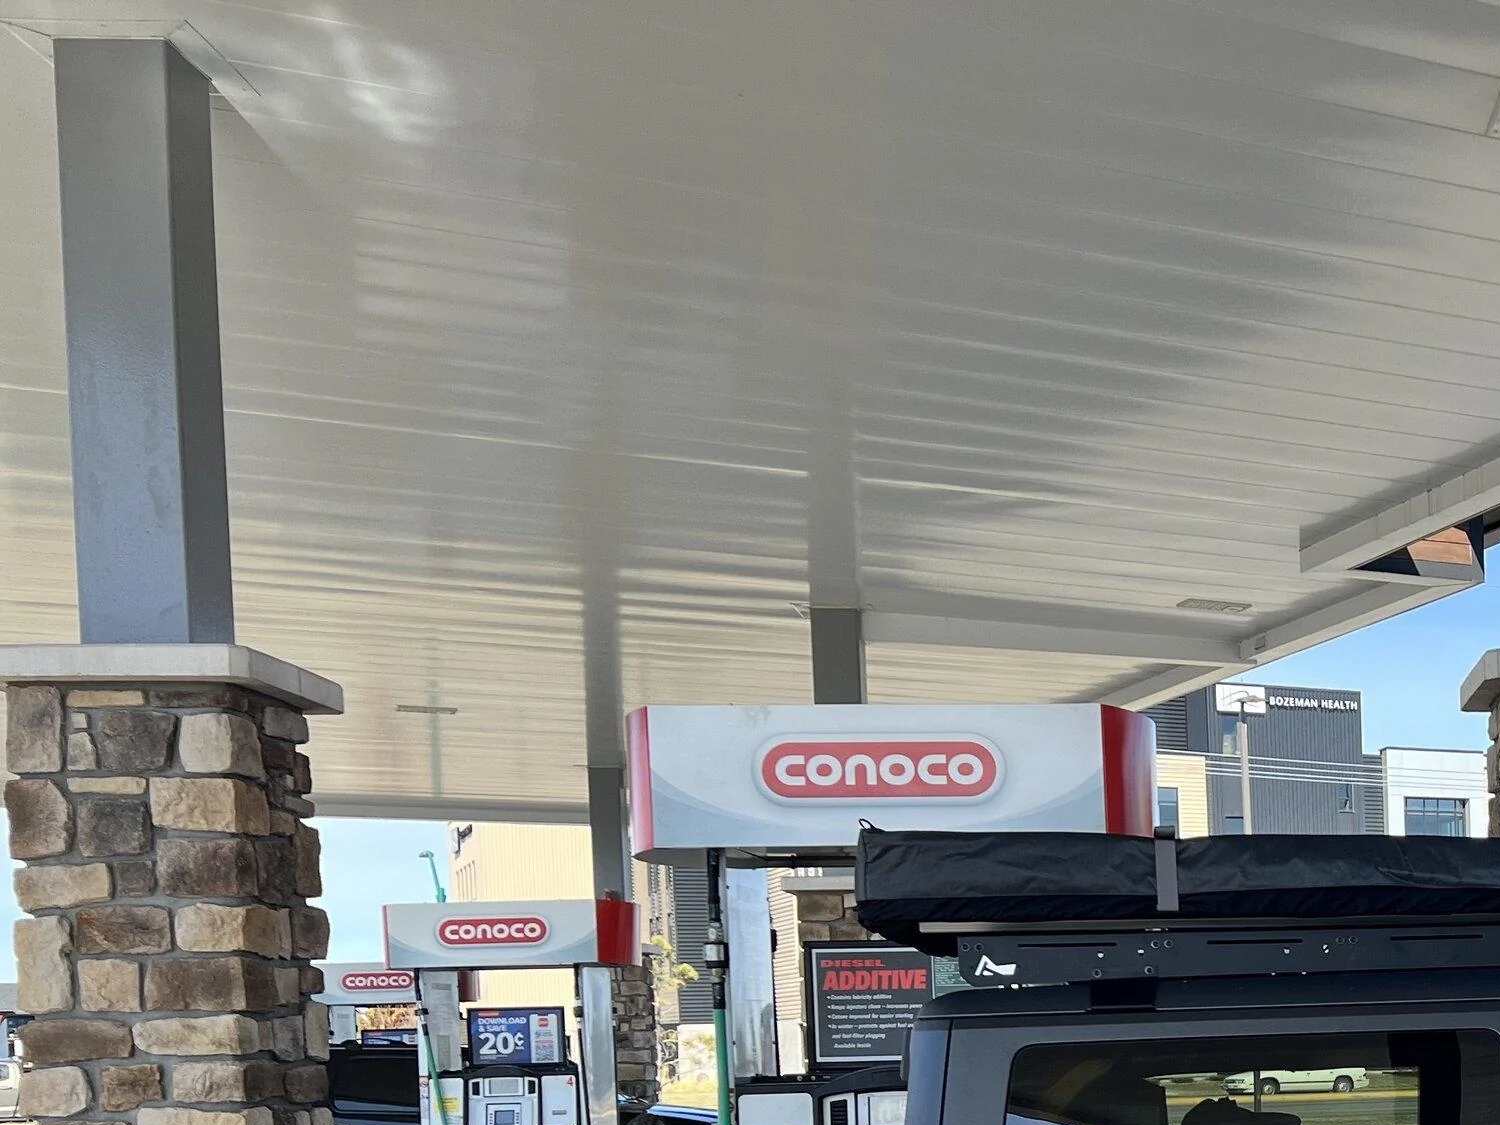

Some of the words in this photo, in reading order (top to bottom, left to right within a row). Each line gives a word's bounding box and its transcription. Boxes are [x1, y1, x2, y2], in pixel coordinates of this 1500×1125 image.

[1269, 696, 1318, 708] BOZEMAN
[1321, 699, 1358, 711] HEALTH
[775, 754, 984, 786] conoco
[444, 922, 541, 940] conoco
[820, 959, 885, 968] DIESEL
[345, 975, 411, 987] conoco
[822, 969, 927, 991] ADDITIVE
[478, 1017, 527, 1025] DOWNLOAD
[566, 1076, 574, 1086] 4
